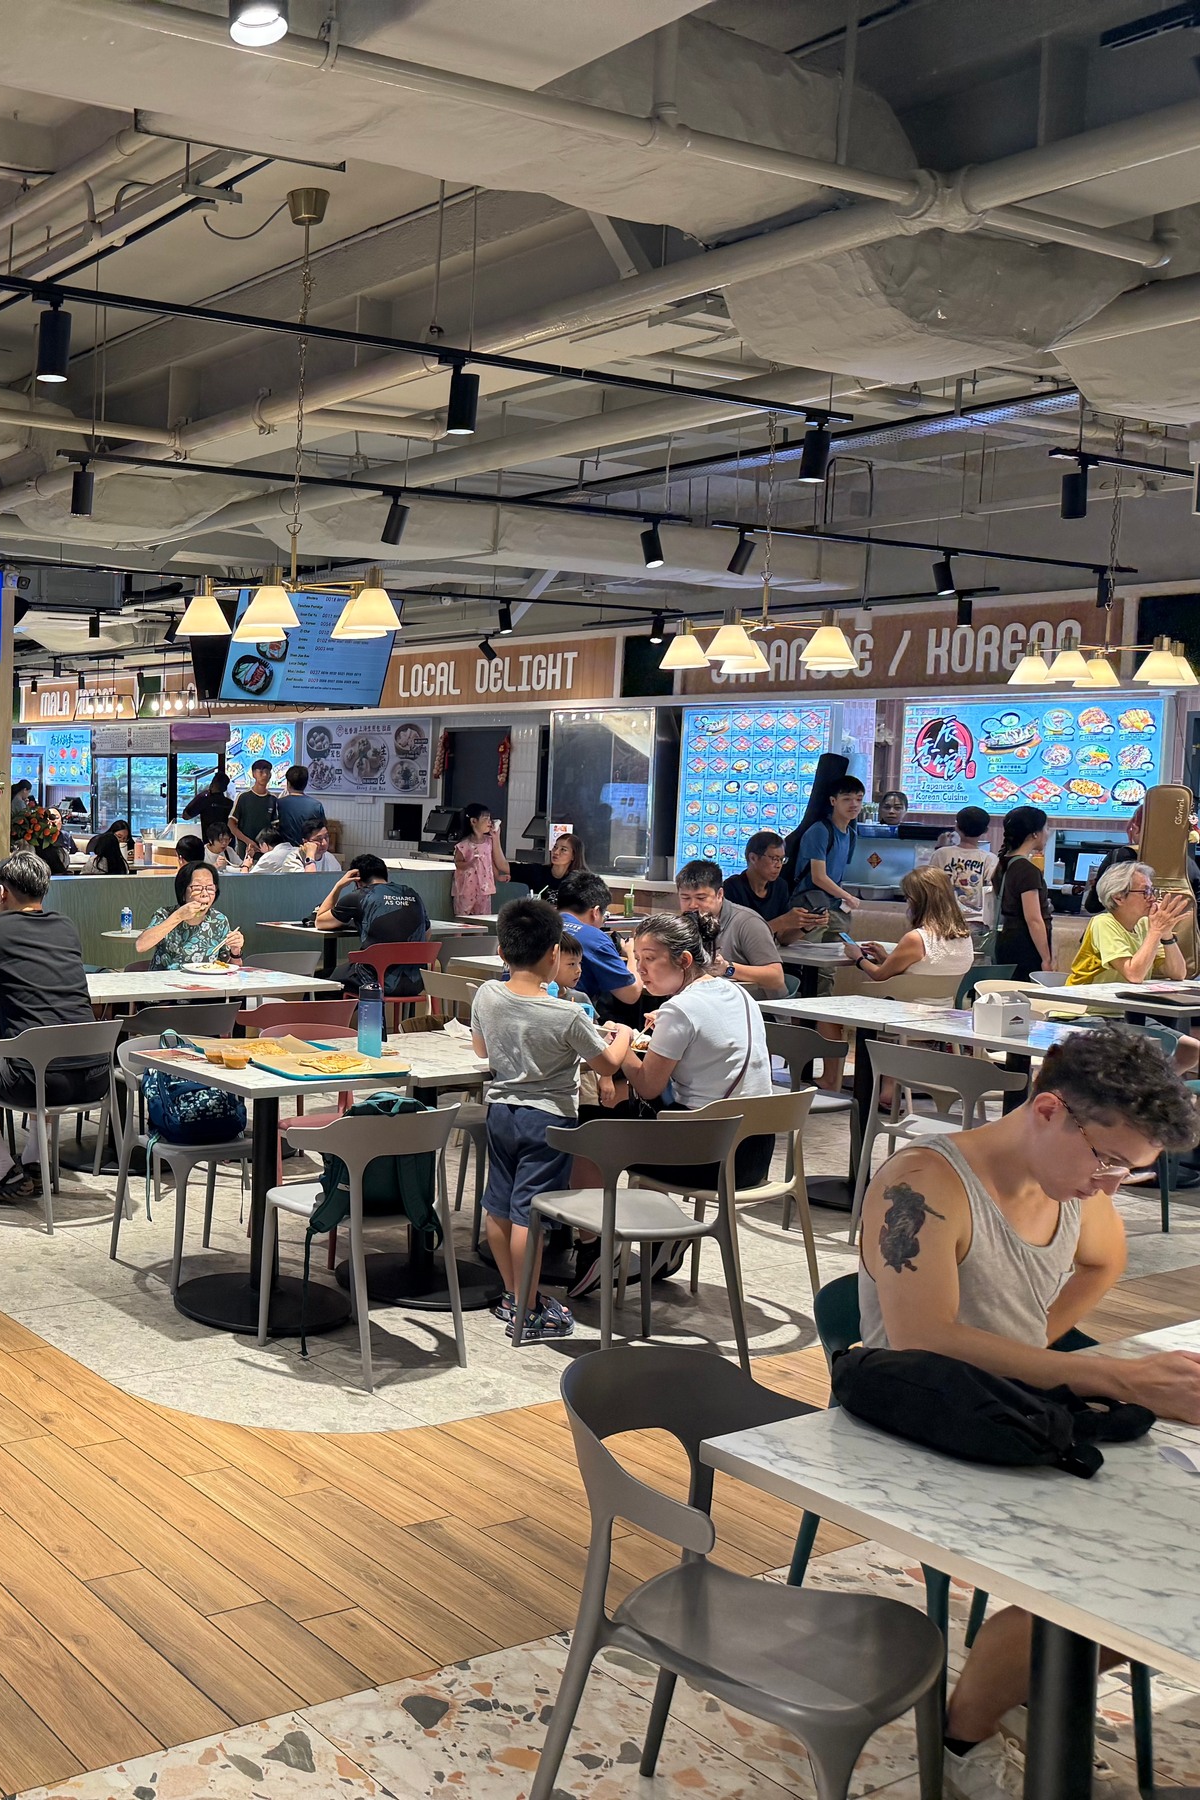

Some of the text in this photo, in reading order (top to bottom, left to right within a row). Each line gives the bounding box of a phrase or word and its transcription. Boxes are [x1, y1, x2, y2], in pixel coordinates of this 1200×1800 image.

[399, 652, 578, 698] LOCAL DELIGHT
[40, 691, 70, 716] MALA
[922, 782, 964, 793] Japanese &
[915, 792, 968, 802] Korean Cuisine
[383, 894, 416, 902] RECHARGE
